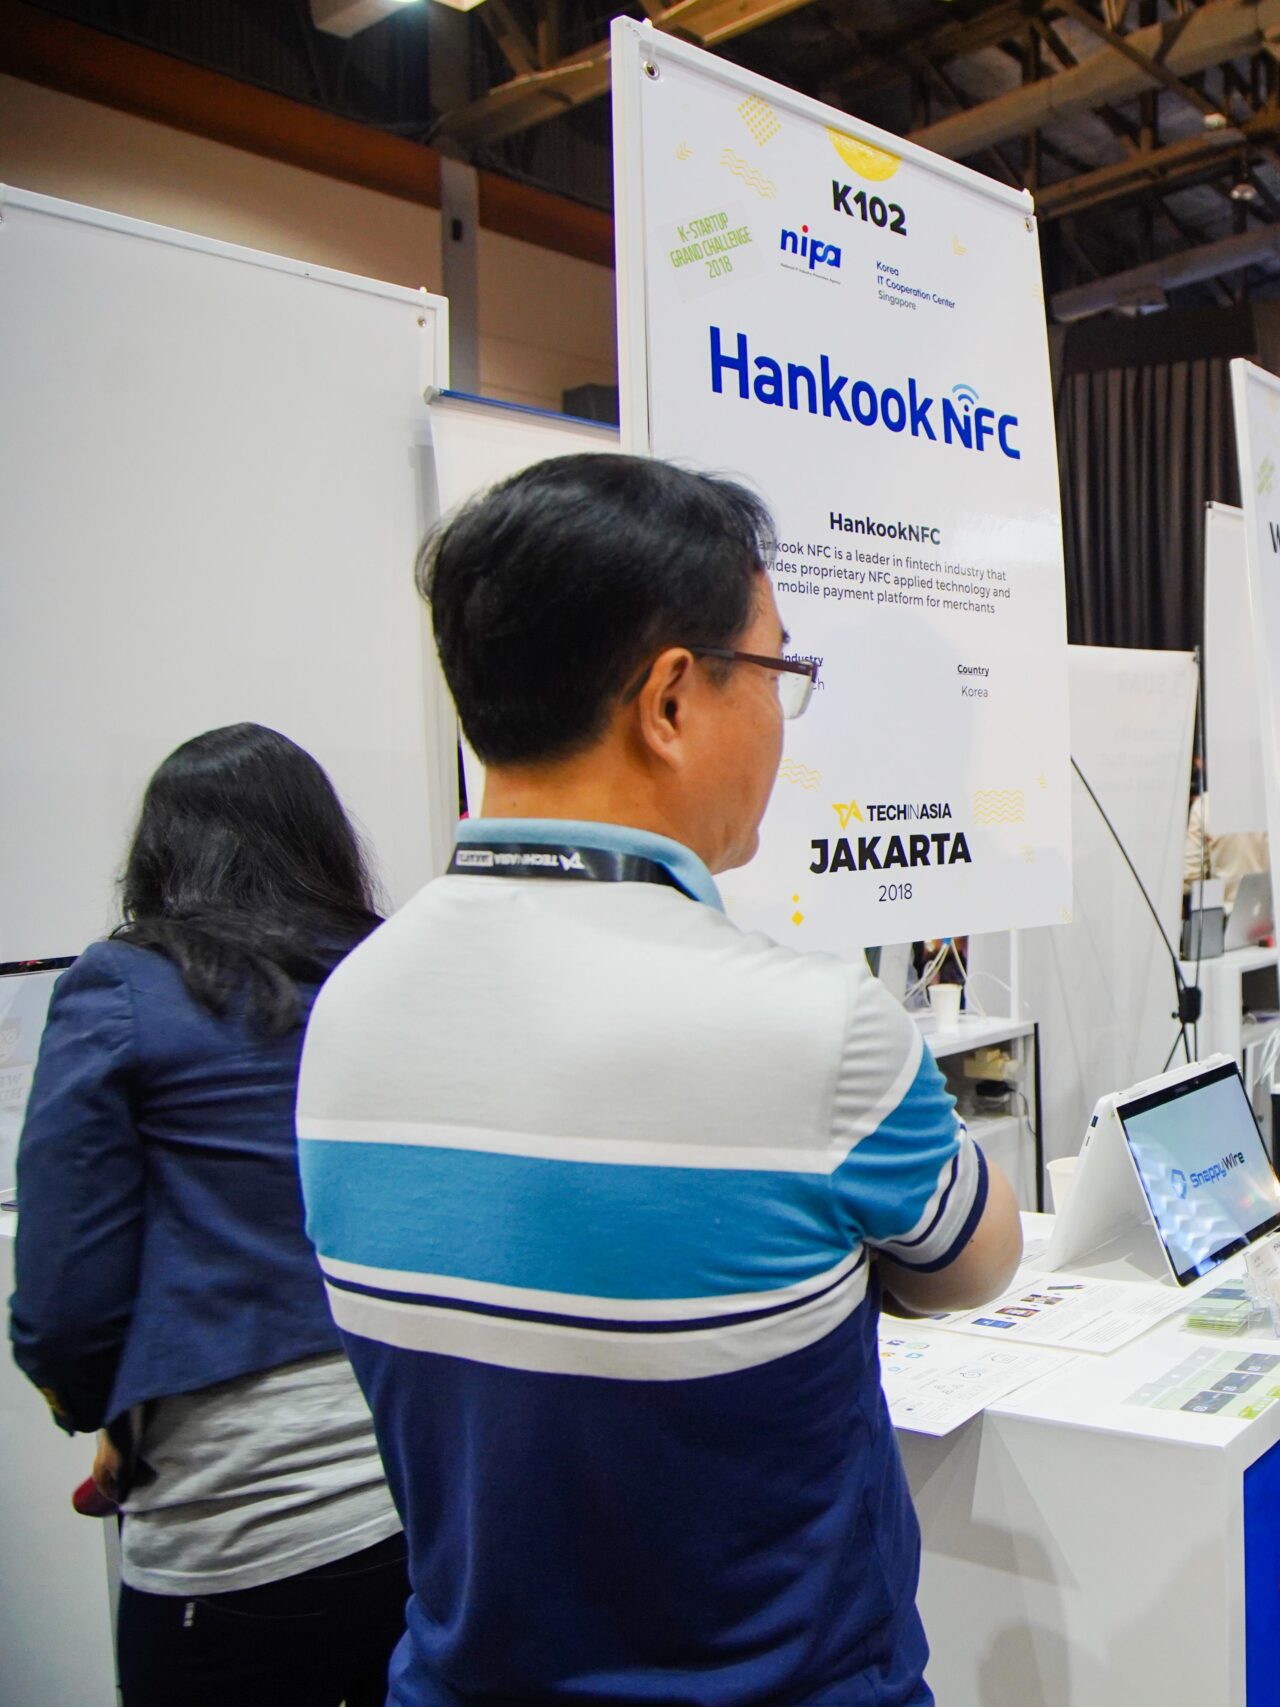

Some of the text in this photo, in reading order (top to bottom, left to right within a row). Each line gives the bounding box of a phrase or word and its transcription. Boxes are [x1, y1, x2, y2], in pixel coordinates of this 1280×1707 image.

[832, 180, 907, 236] K102
[677, 212, 729, 242] K-STARTUP
[670, 226, 752, 268] GRAND CHALLENGE
[780, 225, 842, 270] nipa
[705, 255, 733, 279] 2018
[876, 260, 899, 276] Korea
[877, 275, 956, 309] IT Cooperation Center
[878, 290, 917, 310] Singapore
[830, 511, 941, 545] HankookNFC
[759, 539, 1006, 581] ankook NFC is a leader in fintech industry that
[777, 581, 995, 614] mobile payment platform for merchants
[800, 565, 866, 584] proprietary
[869, 571, 891, 585] NFC
[894, 576, 933, 589] applied
[936, 580, 990, 598] technology
[993, 588, 1010, 598] and
[957, 664, 990, 677] Country
[961, 685, 989, 698] Korea
[866, 802, 952, 822] TECHINASIA
[809, 832, 972, 874] JAKARTA
[878, 883, 913, 903] 2018
